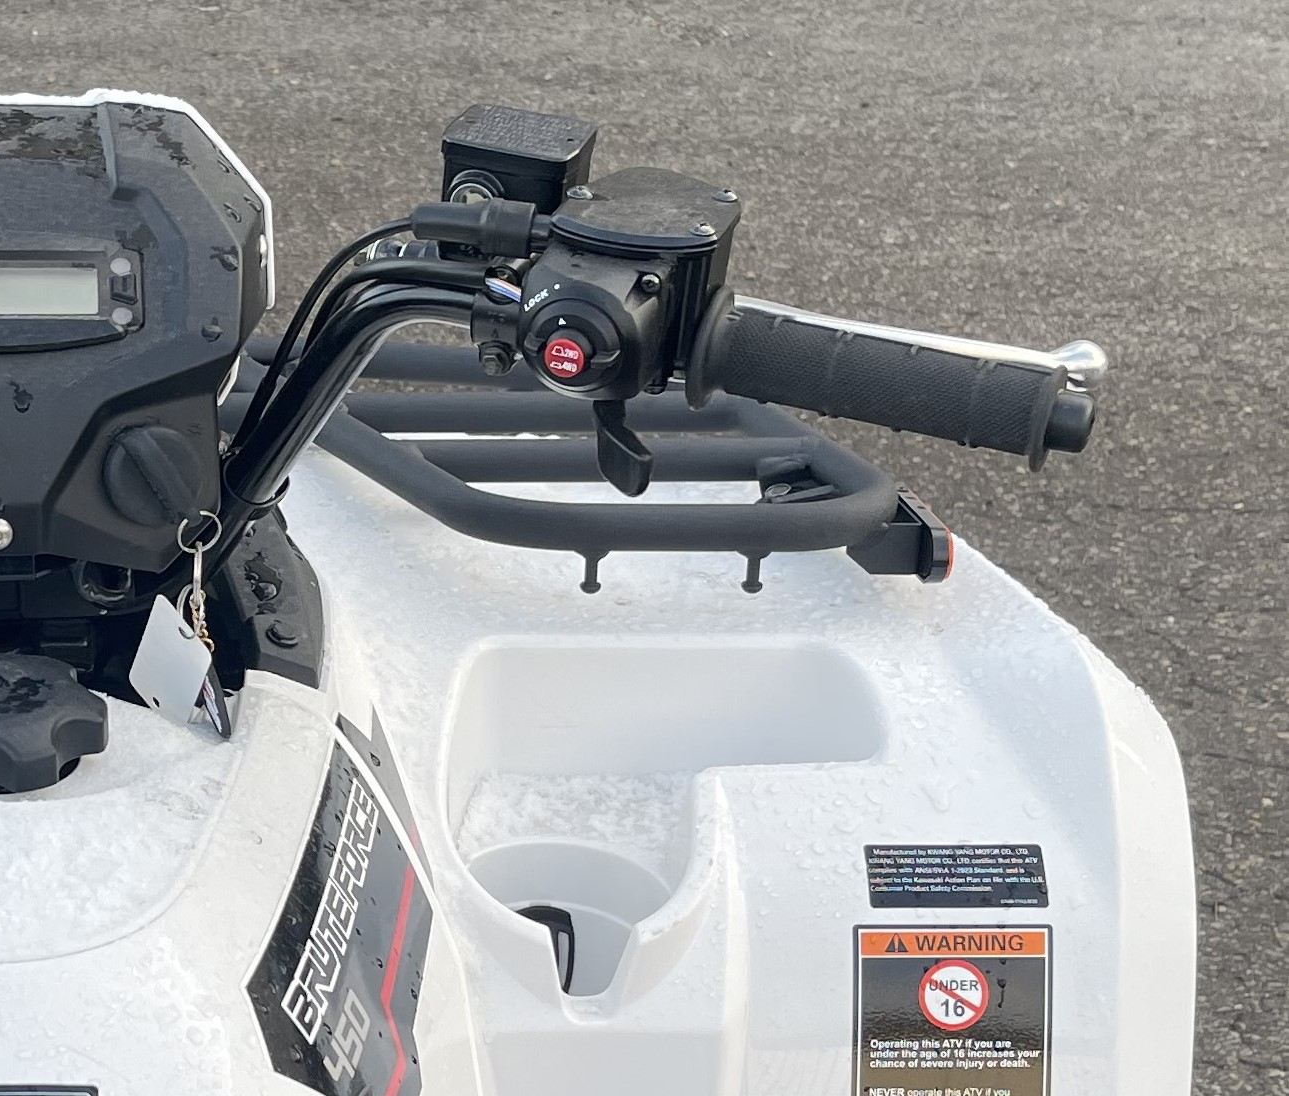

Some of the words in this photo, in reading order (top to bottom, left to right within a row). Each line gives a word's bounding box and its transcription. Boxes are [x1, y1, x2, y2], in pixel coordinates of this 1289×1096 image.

[523, 289, 549, 312] LOCK
[281, 778, 379, 1045] BRUTEFORCE
[916, 935, 1024, 951] WARNING
[929, 980, 979, 991] UNDER
[941, 999, 964, 1017] 16
[323, 989, 371, 1081] 450
[870, 1040, 919, 1049] Operating
[922, 1040, 940, 1048] this
[942, 1040, 962, 1048] ATV
[965, 1040, 972, 1048] if
[974, 1042, 993, 1050] you
[870, 1050, 899, 1058] under
[902, 1050, 917, 1058] the
[919, 1052, 937, 1060] age
[940, 1050, 951, 1058] of
[954, 1050, 964, 1058] 16
[968, 1050, 1014, 1058] increases
[1017, 1051, 1040, 1059] your
[870, 1060, 905, 1068] chance
[908, 1060, 918, 1068] of
[957, 1060, 984, 1069] injury
[1000, 1059, 1030, 1068] death.
[869, 1089, 904, 1096] NEVER
[945, 1089, 961, 1096] this
[963, 1089, 983, 1096] ATV
[985, 1088, 991, 1096] if
